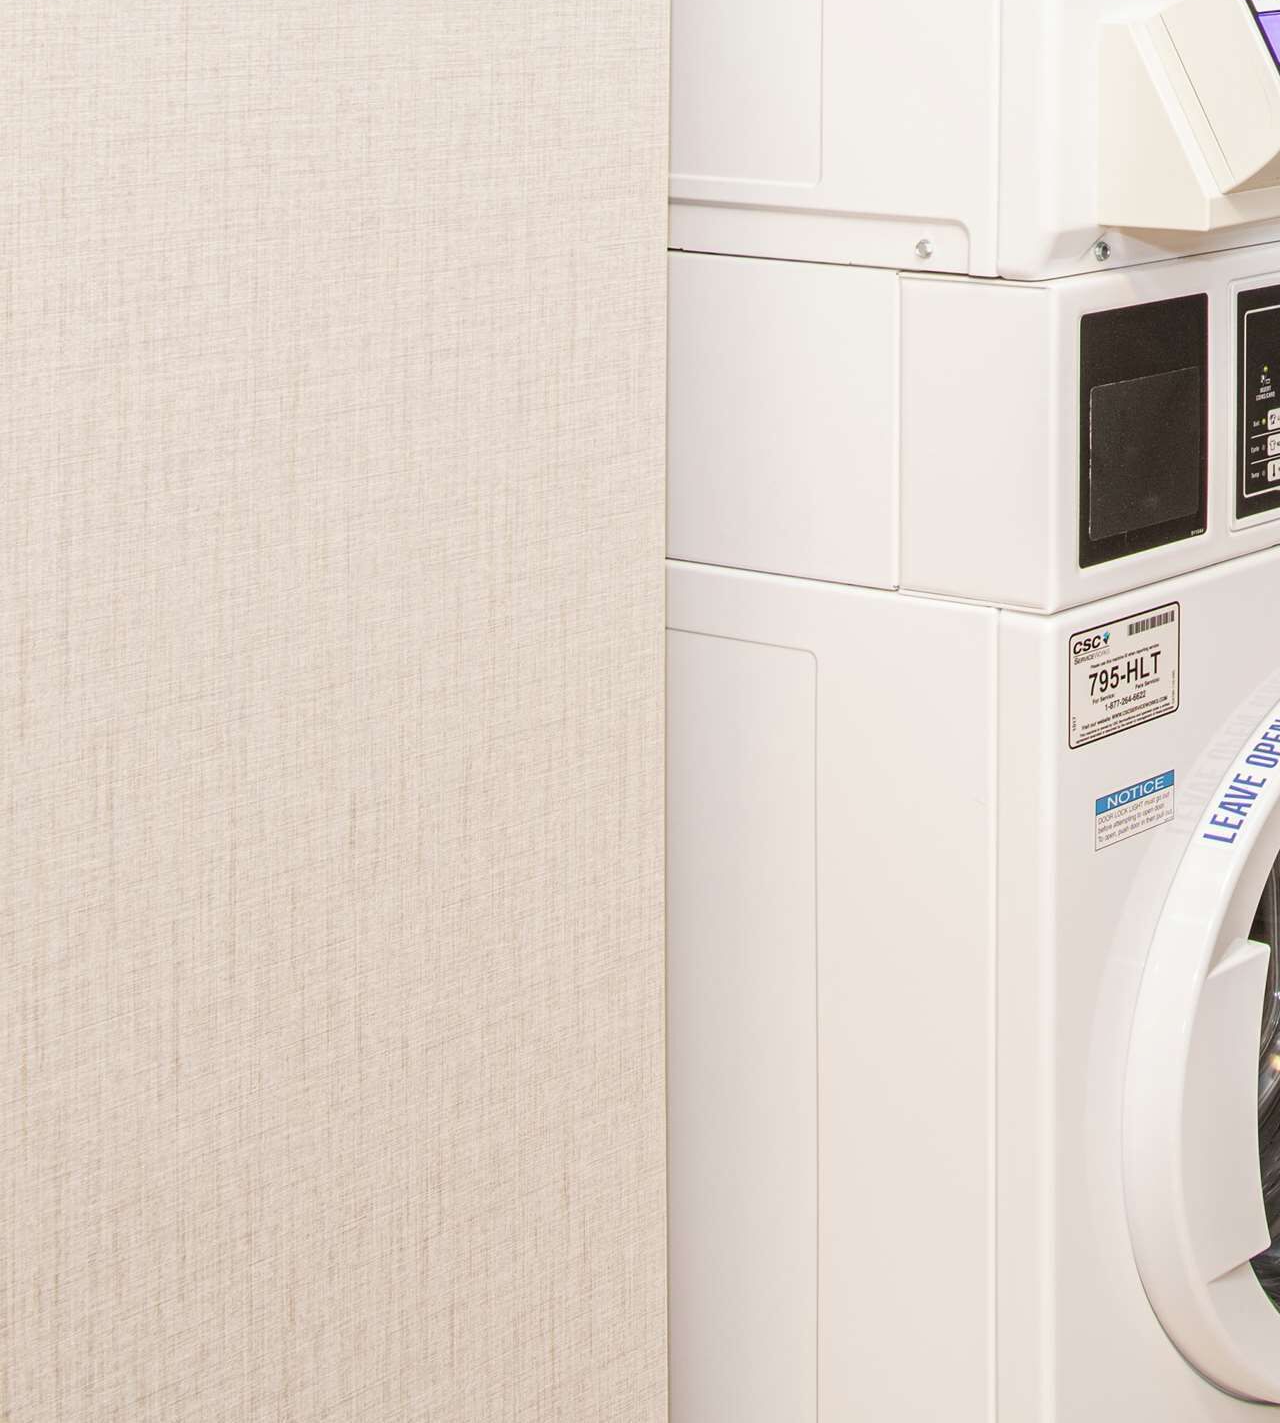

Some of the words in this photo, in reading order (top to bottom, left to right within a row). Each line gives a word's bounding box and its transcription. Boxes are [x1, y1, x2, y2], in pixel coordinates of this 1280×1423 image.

[1073, 635, 1101, 655] CSC
[1089, 651, 1161, 696] 795-HLT
[1105, 690, 1146, 710] 1-877-264-6622
[1108, 776, 1164, 809] NOTICE
[1098, 814, 1113, 825] DOOR
[1114, 809, 1127, 819] LOCK
[1203, 773, 1267, 844] LEAVE
